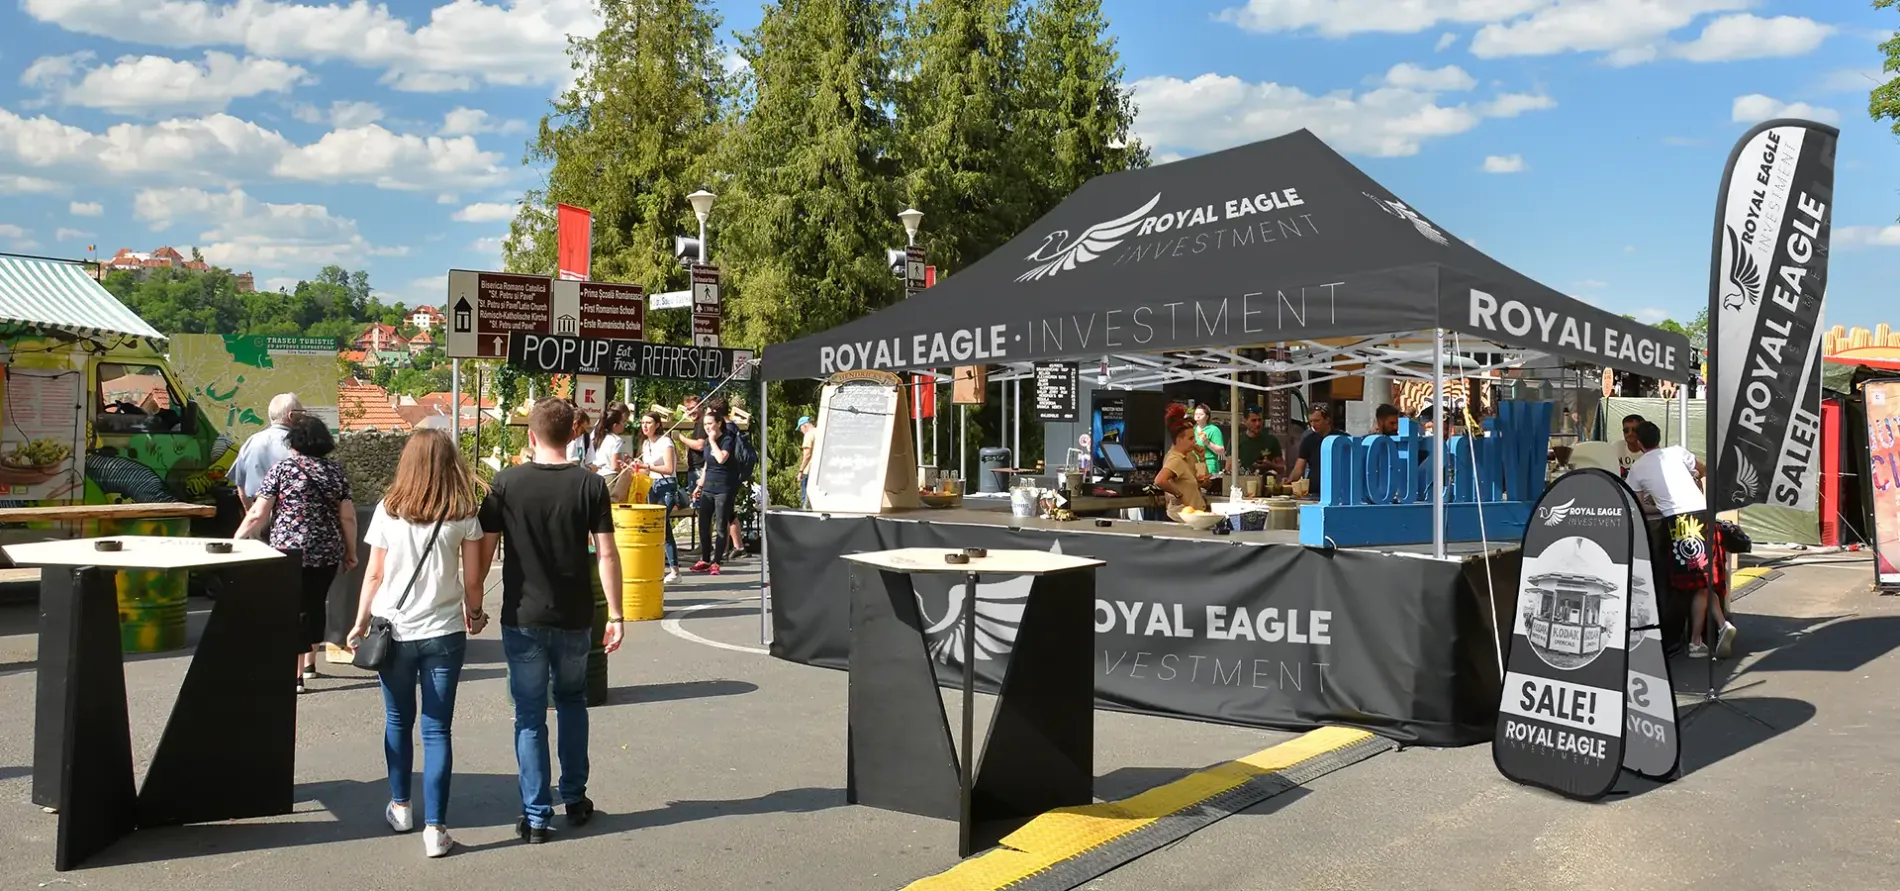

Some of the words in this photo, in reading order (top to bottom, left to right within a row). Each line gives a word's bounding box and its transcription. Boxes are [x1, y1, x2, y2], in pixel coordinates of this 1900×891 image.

[1742, 190, 1765, 245] ROYAL
[1757, 130, 1780, 186] EAGLE
[1758, 141, 1796, 253] INVESTMENT
[1137, 205, 1218, 237] ROYAL
[1226, 188, 1305, 220] EAGLE
[1113, 214, 1321, 266] INVESTMENT
[481, 280, 503, 290] Biserica
[503, 282, 524, 291] Romano
[499, 291, 513, 299] Petru
[584, 288, 598, 298] Prima
[487, 300, 500, 309] Petru
[530, 303, 547, 311] Church
[531, 312, 547, 321] Kirche
[584, 304, 595, 313] First
[596, 304, 618, 314] Romanian
[619, 305, 635, 315] School
[1028, 282, 1345, 353] INVESTMENT
[1738, 318, 1793, 434] ROYAL
[1772, 191, 1825, 313] EAGLE
[499, 321, 511, 329] Petru
[584, 319, 596, 328] Erste
[626, 320, 641, 331] Schule
[1469, 288, 1597, 353] ROYAL
[1604, 327, 1676, 371] EAGLE
[523, 334, 576, 370] POP
[580, 340, 609, 369] UP
[616, 344, 633, 357] Eat
[640, 345, 723, 378] REFRESHED
[821, 338, 906, 374] ROYAL
[912, 324, 1007, 364] EAGLE
[1775, 407, 1820, 506] SALE!
[1568, 517, 1621, 527] INVESTMENT
[1569, 507, 1596, 516] ROYAL
[1597, 507, 1622, 517] EAGLE
[1095, 600, 1194, 639] OYAL
[1206, 605, 1332, 645] EAGLE
[1553, 628, 1580, 640] KODAK
[1103, 650, 1331, 694] VESTMENT
[1520, 681, 1597, 726] SALE!
[1505, 720, 1554, 748] ROYAL
[1557, 731, 1607, 760] EAGLE
